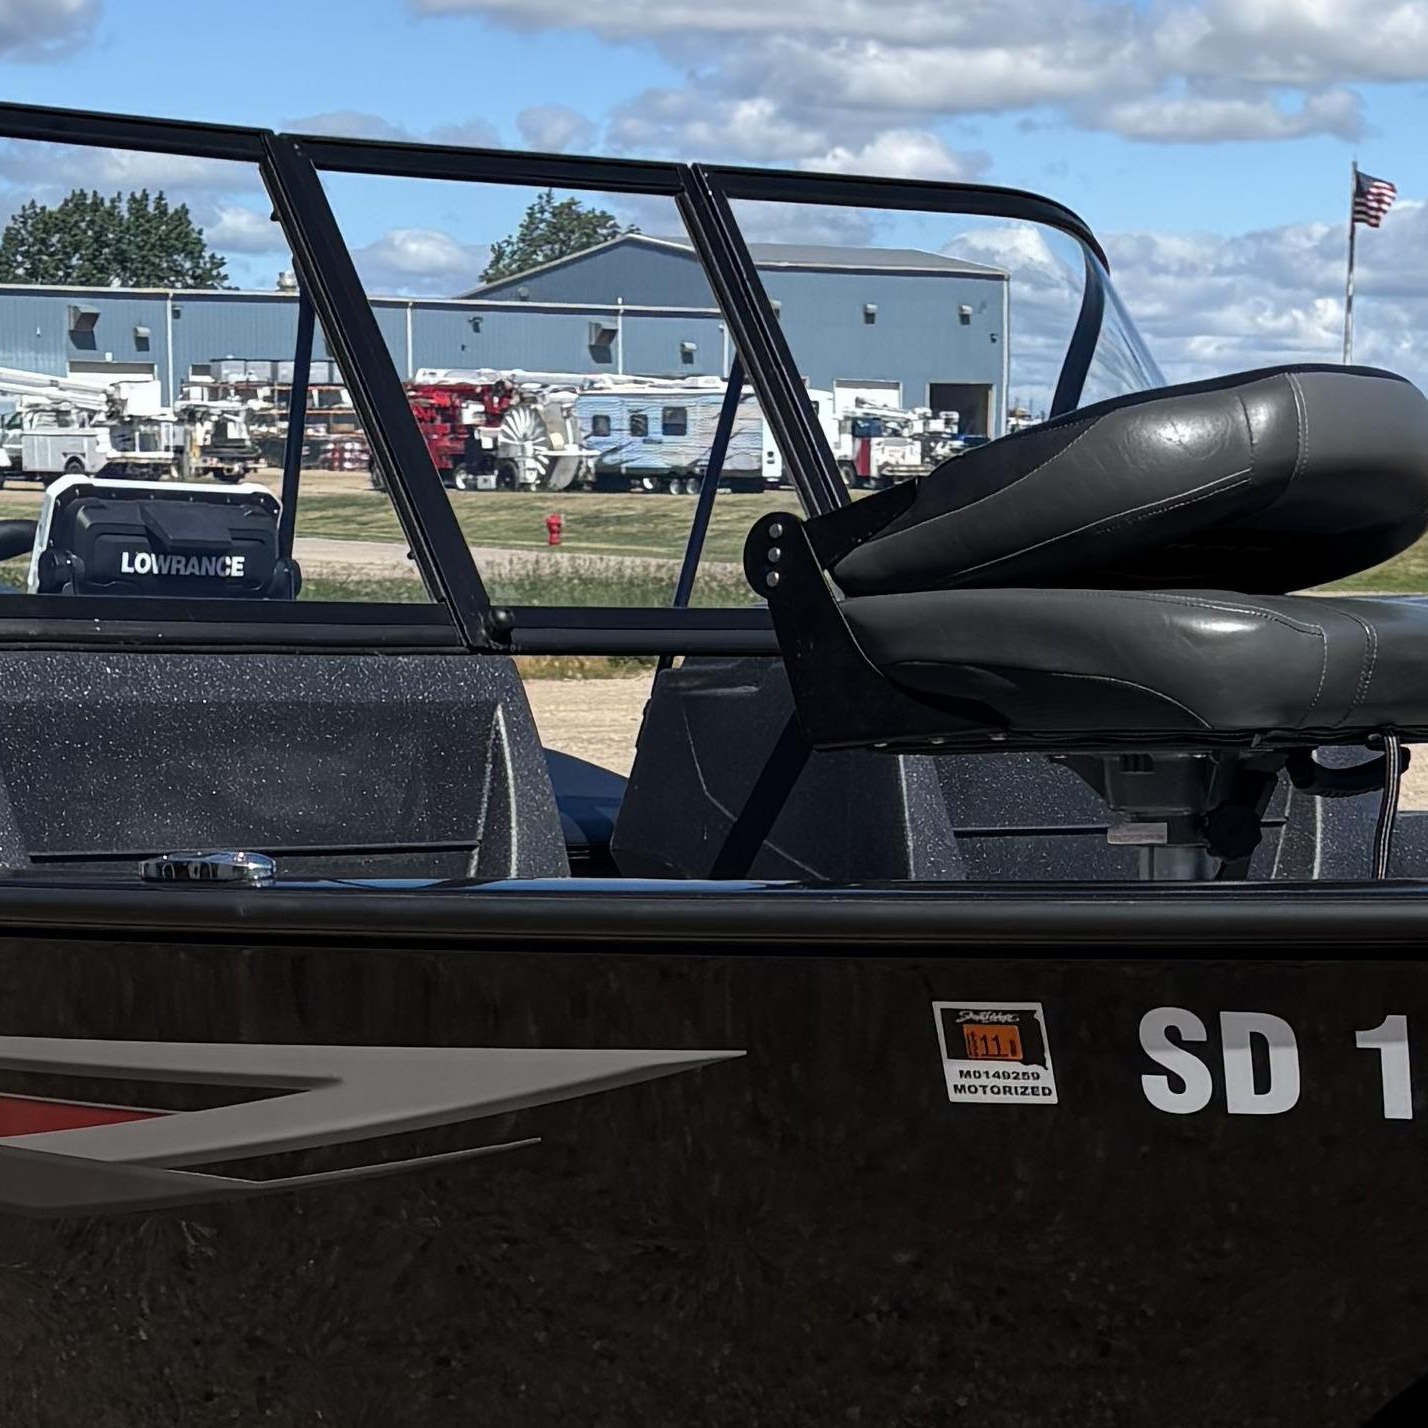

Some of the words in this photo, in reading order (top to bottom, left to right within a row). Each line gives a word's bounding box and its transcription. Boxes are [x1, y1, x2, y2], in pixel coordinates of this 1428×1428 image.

[120, 551, 246, 577] LOWRANCE
[1138, 1006, 1301, 1115] SD
[953, 1083, 1053, 1097] MOTORIZED
